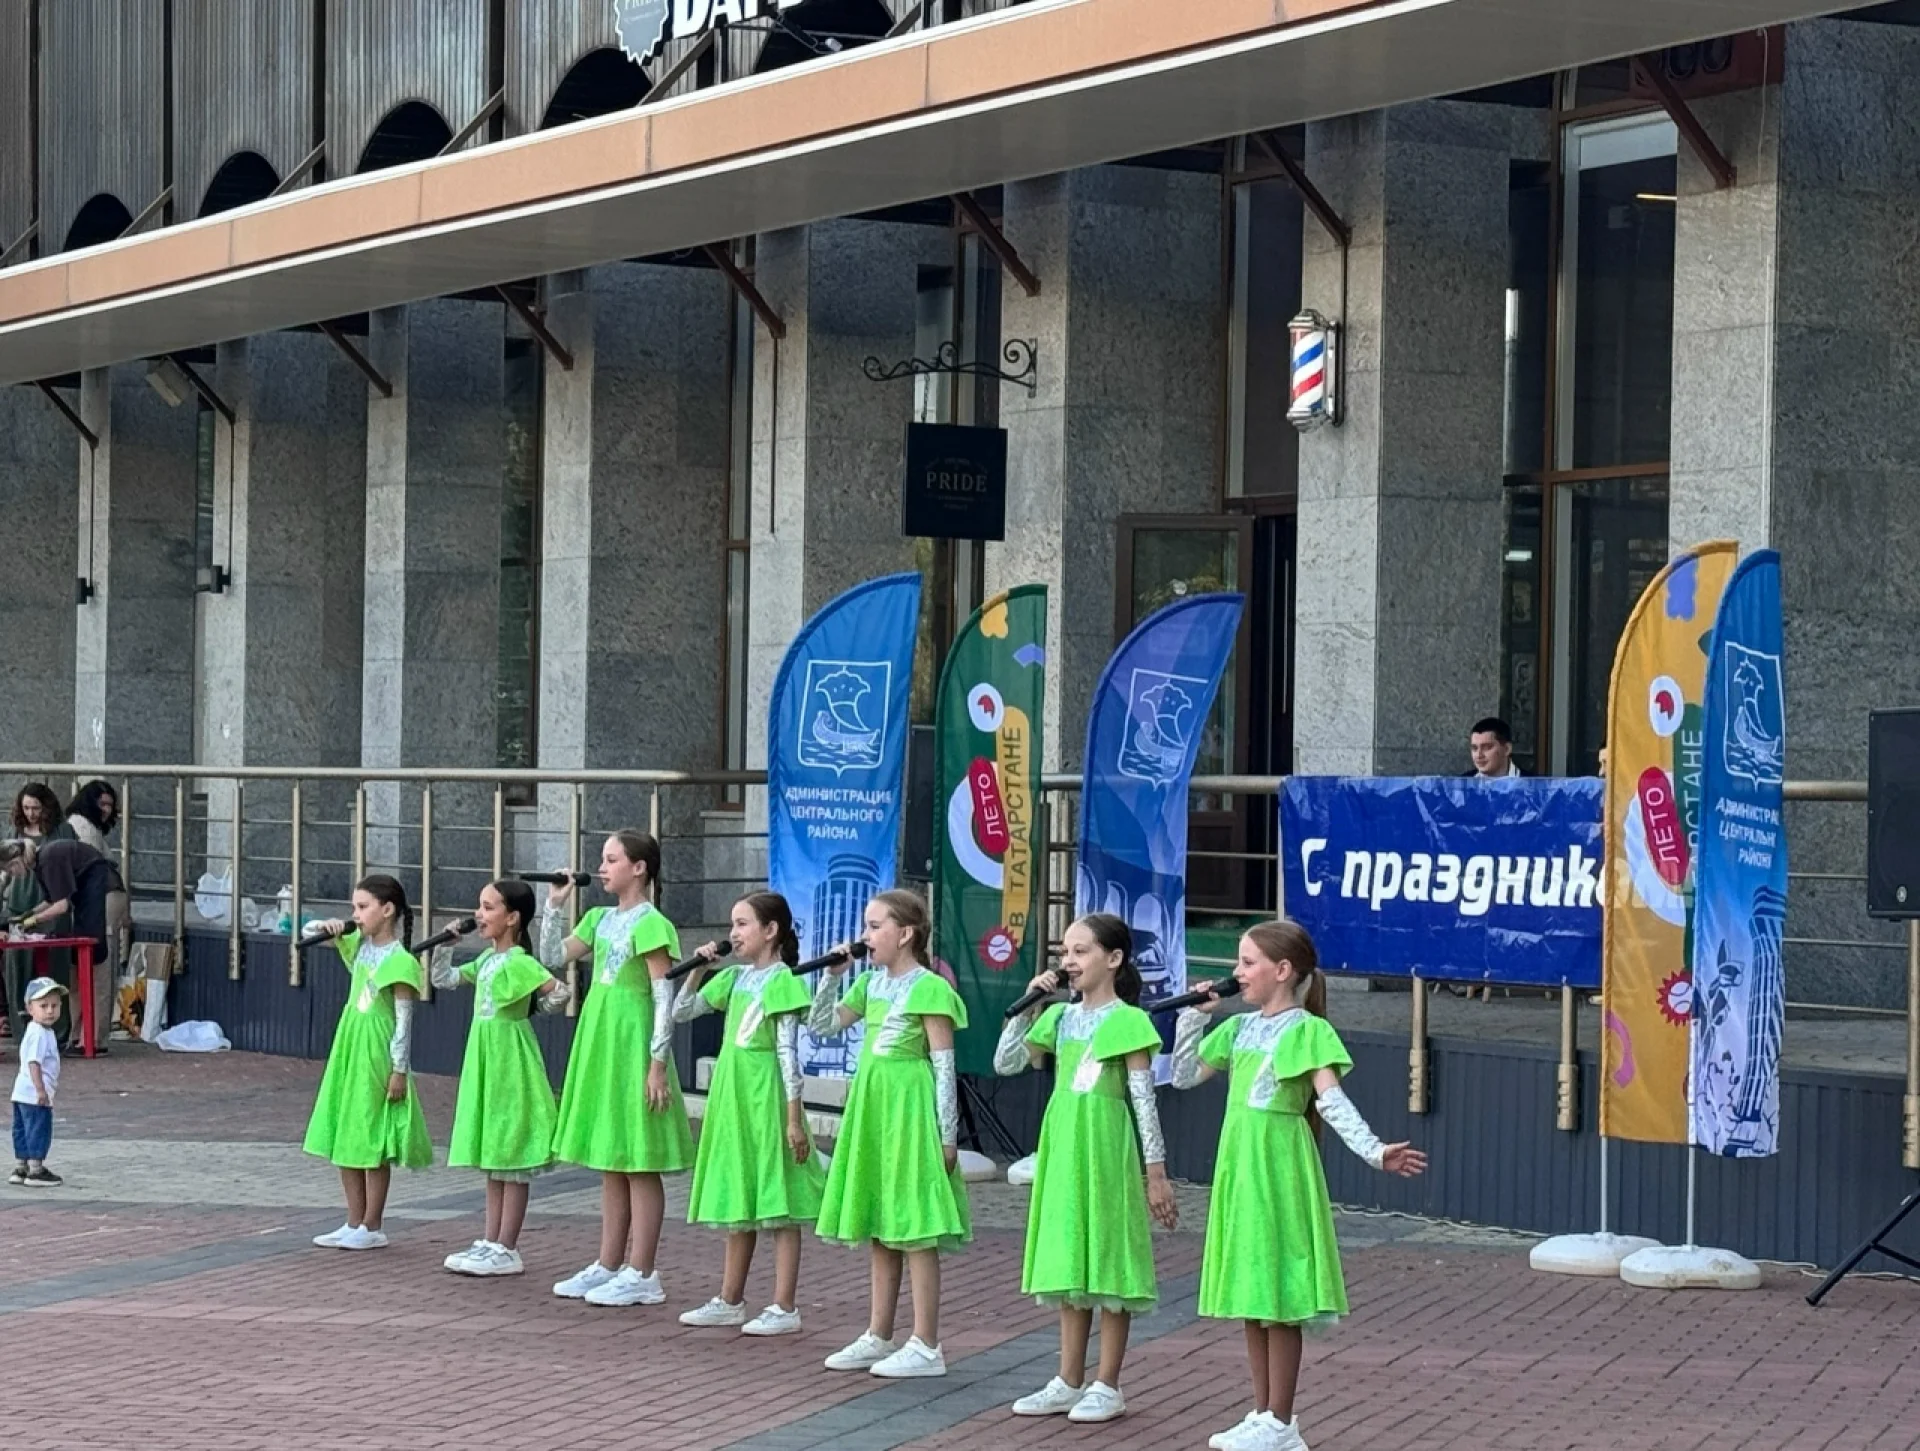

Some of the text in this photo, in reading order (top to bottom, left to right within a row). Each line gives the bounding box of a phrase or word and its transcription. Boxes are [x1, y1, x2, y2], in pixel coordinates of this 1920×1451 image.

[926, 471, 988, 493] PRIDE
[790, 805, 885, 822] ЦЕНТРАЛЬНОГО
[807, 824, 859, 840] РАЙОНА
[977, 773, 1004, 837] ЛЕТО
[1001, 727, 1028, 927] В ТАТАРСТАНЕ
[1646, 787, 1680, 864] ЛЕТО
[1301, 838, 1606, 916] С праздник
